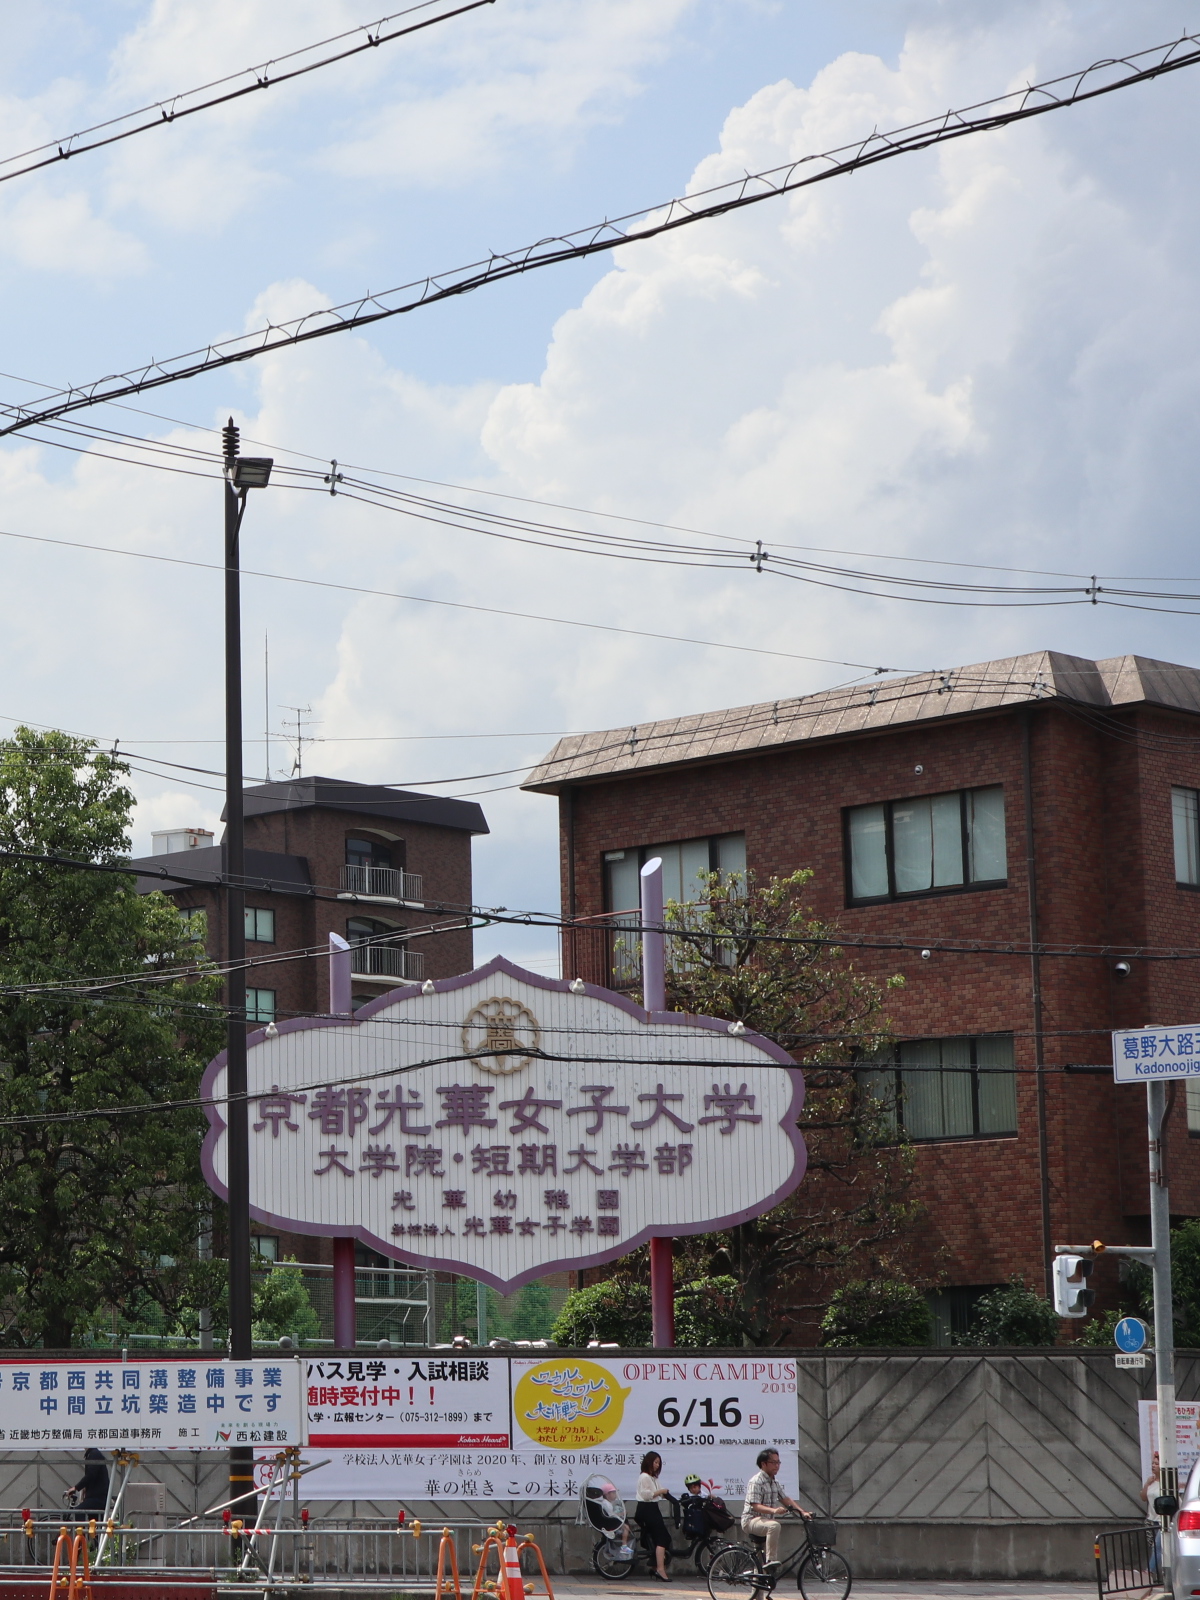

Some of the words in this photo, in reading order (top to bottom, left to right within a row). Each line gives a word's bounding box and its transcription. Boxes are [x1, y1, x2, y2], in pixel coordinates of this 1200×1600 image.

[248, 1083, 763, 1138] 京都光華女子大学
[313, 1143, 694, 1177] 大学院・短期大学部
[391, 1189, 619, 1210] 光華幼稚園
[462, 1216, 619, 1237] 光華女子学園
[623, 1363, 688, 1381] OPEN
[693, 1363, 796, 1381] CAMPUS
[761, 1383, 796, 1393] 2019
[40, 1393, 282, 1416] 中間立坑築造中です
[657, 1397, 742, 1428] 6/16
[749, 1414, 759, 1425] 日
[9, 1429, 83, 1440] 近畿地方整備局
[87, 1428, 161, 1439] 京都国道事務所
[178, 1428, 200, 1438] 施工
[236, 1430, 288, 1442] 西松建設
[634, 1434, 662, 1445] 9:30
[679, 1434, 715, 1445] 15:00
[458, 1468, 482, 1476] きらめ
[425, 1479, 495, 1497] 華の煌き
[507, 1480, 579, 1497] この未来
